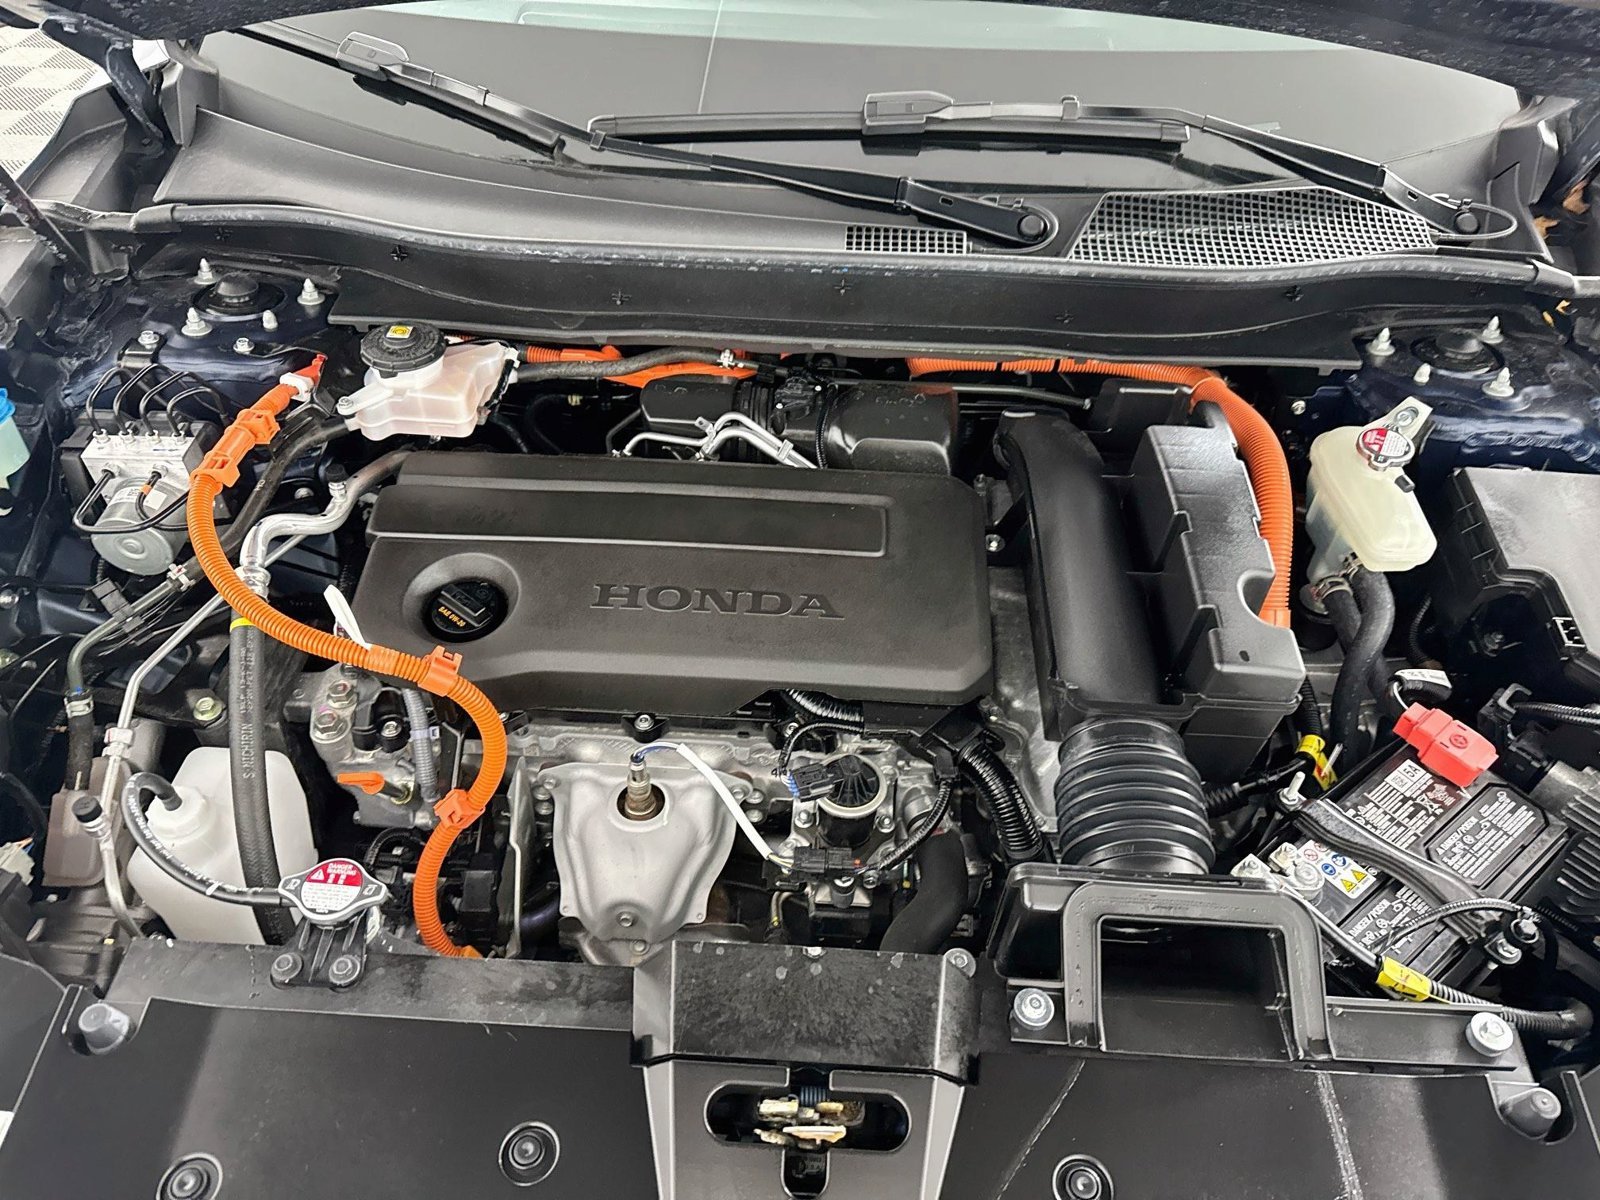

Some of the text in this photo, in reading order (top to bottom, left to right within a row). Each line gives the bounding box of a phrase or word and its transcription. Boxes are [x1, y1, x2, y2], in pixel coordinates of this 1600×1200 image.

[590, 583, 846, 621] HONDA
[438, 606, 467, 627] SAE 0W-20
[1402, 764, 1421, 778] 5A
[328, 862, 354, 870] DANGER
